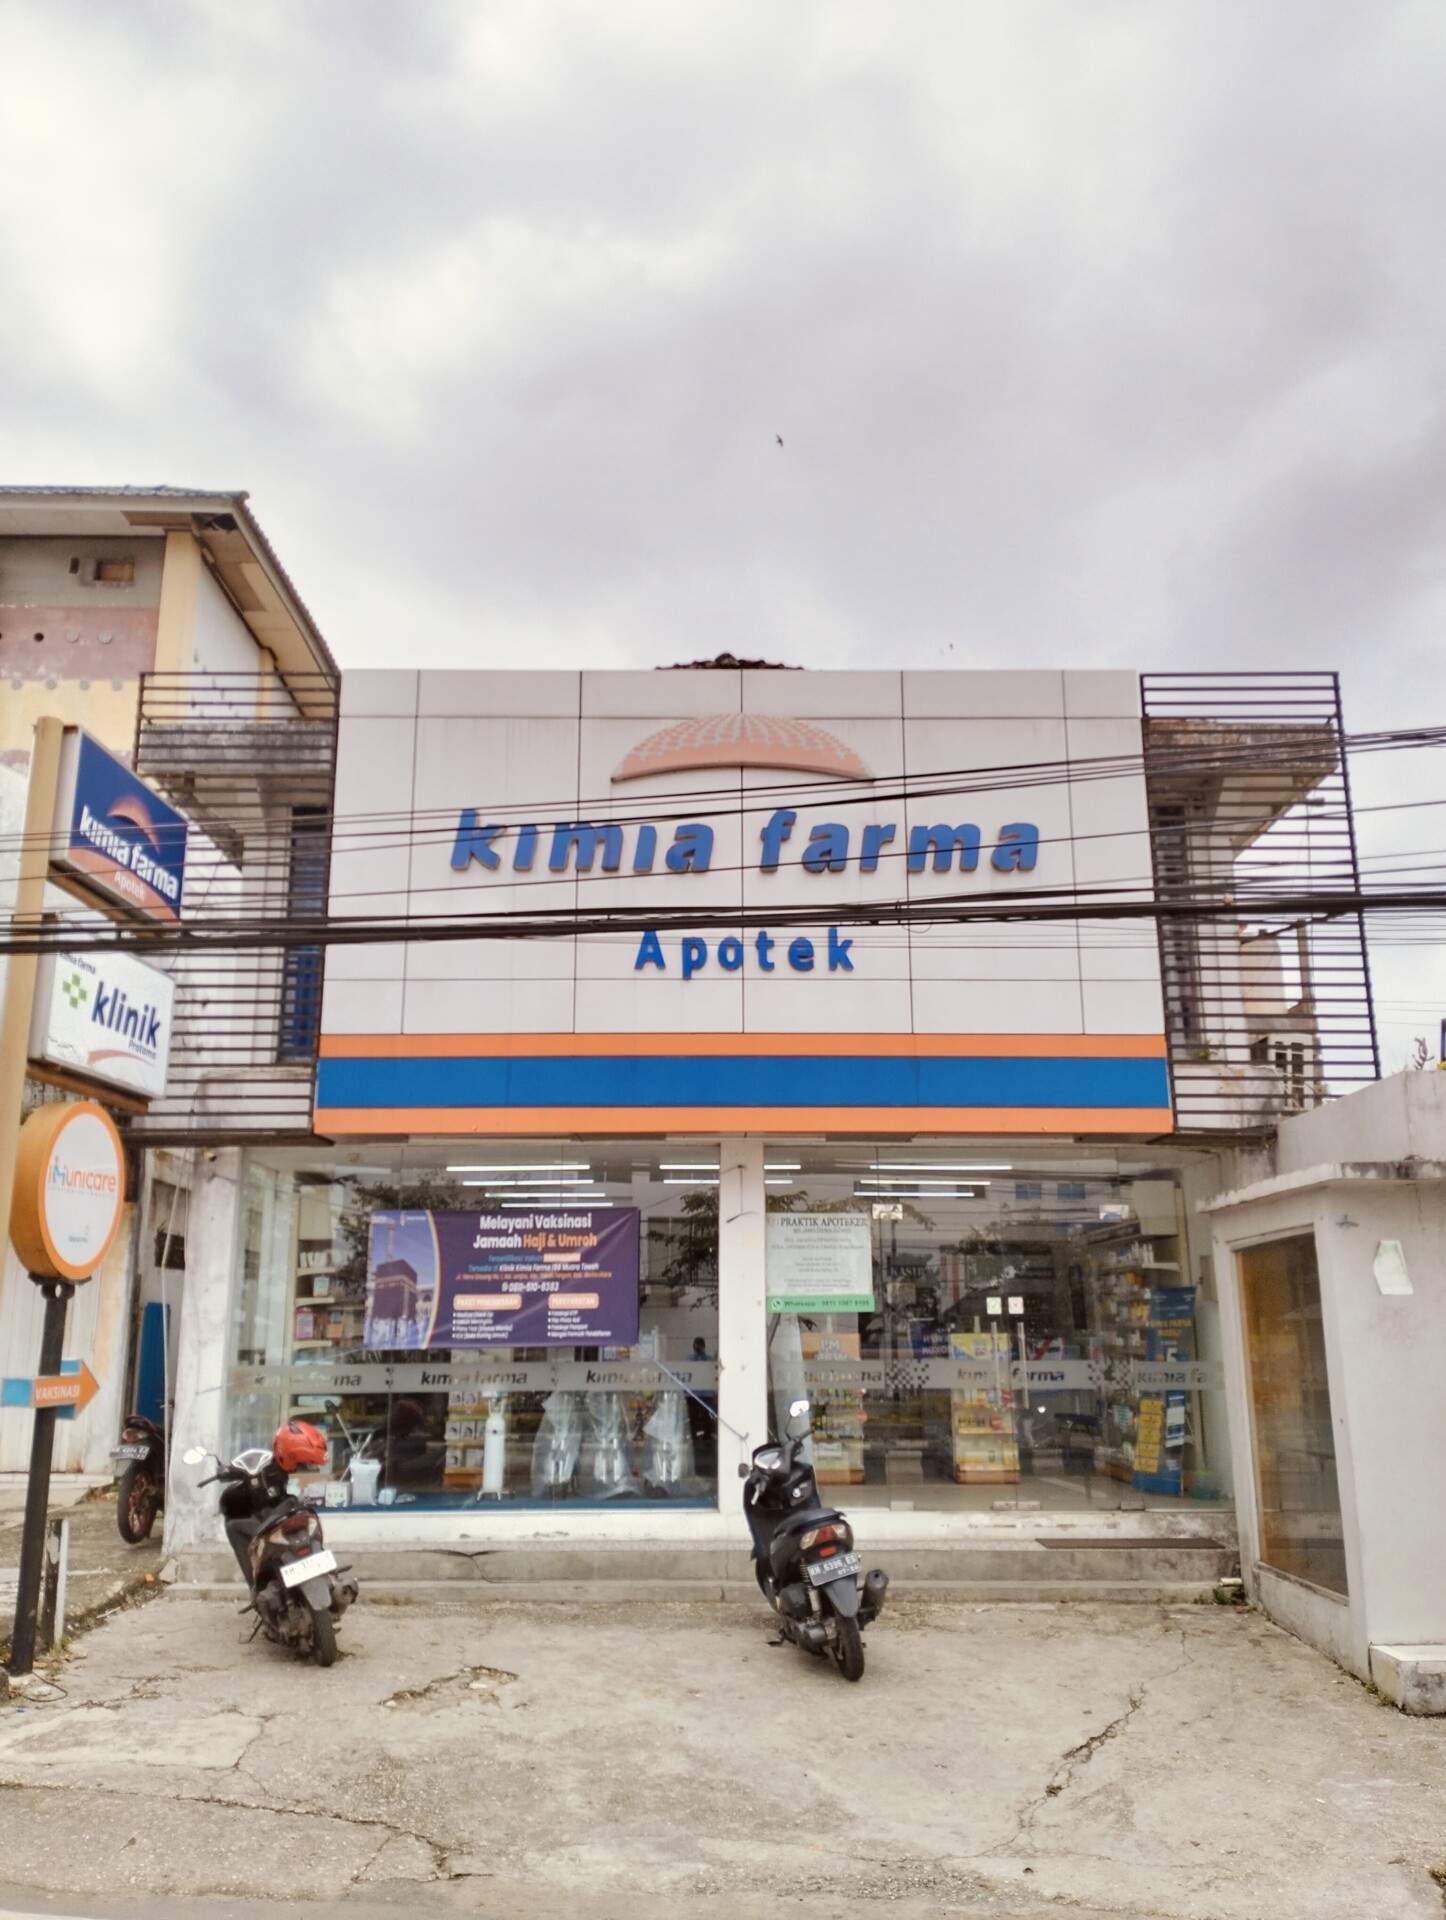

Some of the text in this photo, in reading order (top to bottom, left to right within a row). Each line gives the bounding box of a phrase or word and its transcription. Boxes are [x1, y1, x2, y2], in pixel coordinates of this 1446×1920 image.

[80, 804, 179, 900] kimia farma
[450, 808, 1040, 873] kimia farma
[634, 926, 854, 980] Apotek
[91, 979, 160, 1049] klinik
[480, 1212, 592, 1233] Melayani Vaksinasi
[780, 1217, 818, 1227] PRAKTIK
[473, 1232, 598, 1251] Jamaah Haji & Umroh
[1012, 1368, 1065, 1381] frma
